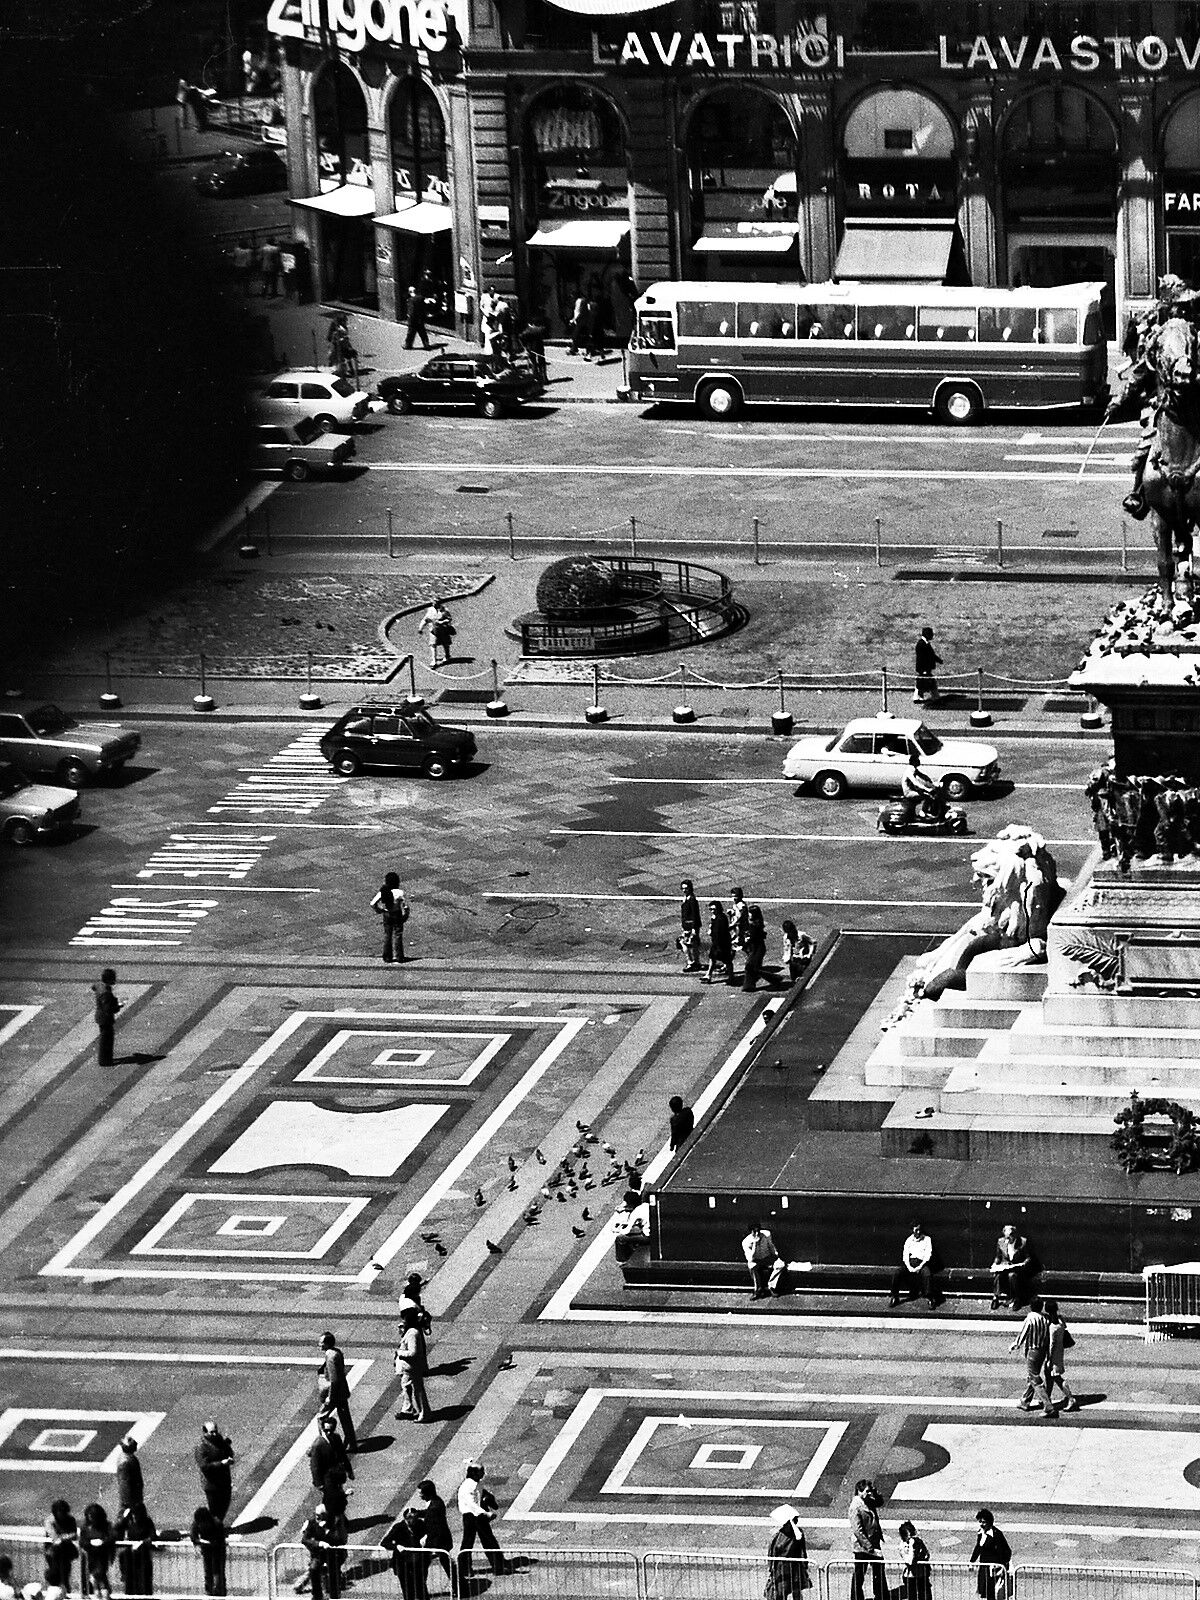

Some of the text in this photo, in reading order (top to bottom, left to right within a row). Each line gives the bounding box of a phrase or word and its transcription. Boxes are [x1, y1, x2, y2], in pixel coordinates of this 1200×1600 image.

[591, 30, 844, 67] LAVATRICI
[858, 183, 941, 200] ROTA
[136, 834, 276, 878] DANTE
[68, 898, 219, 945] SCALA
